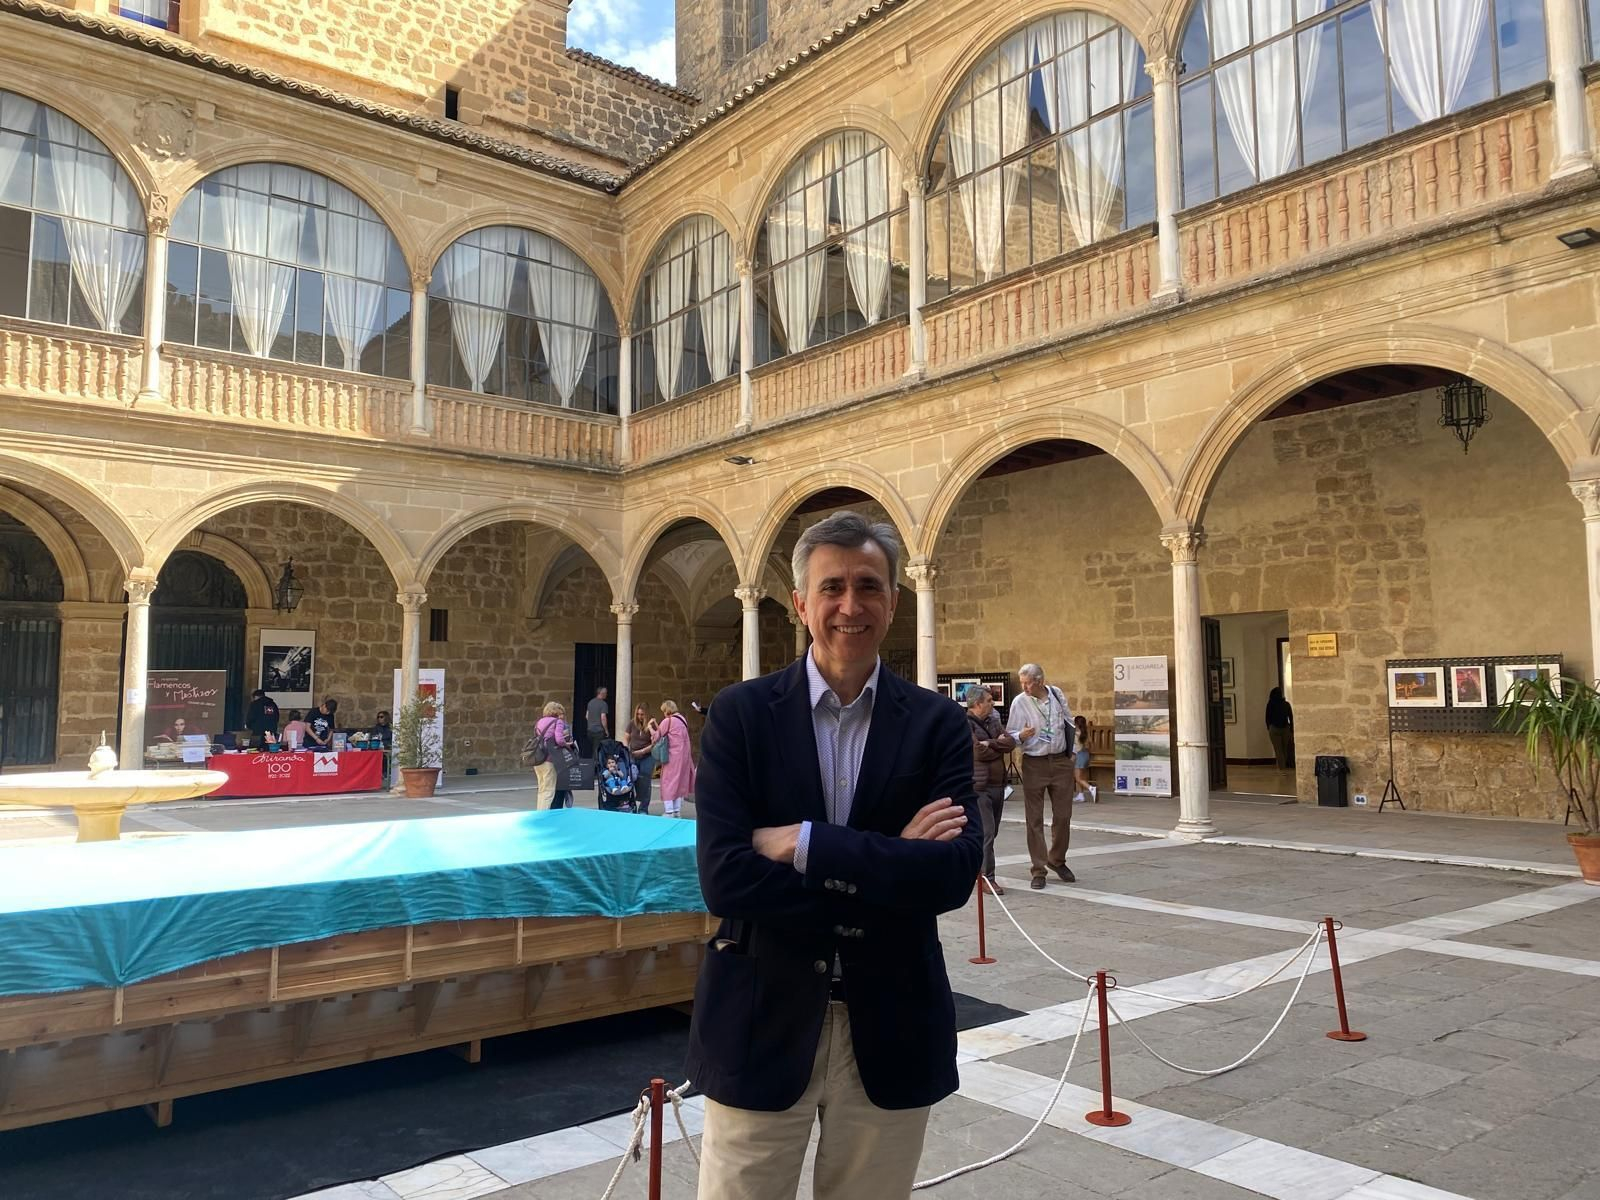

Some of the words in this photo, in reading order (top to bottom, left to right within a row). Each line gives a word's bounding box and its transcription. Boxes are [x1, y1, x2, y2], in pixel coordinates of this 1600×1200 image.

[1115, 664, 1125, 681] 3
[147, 678, 191, 688] Flamencos
[268, 763, 291, 773] 100
